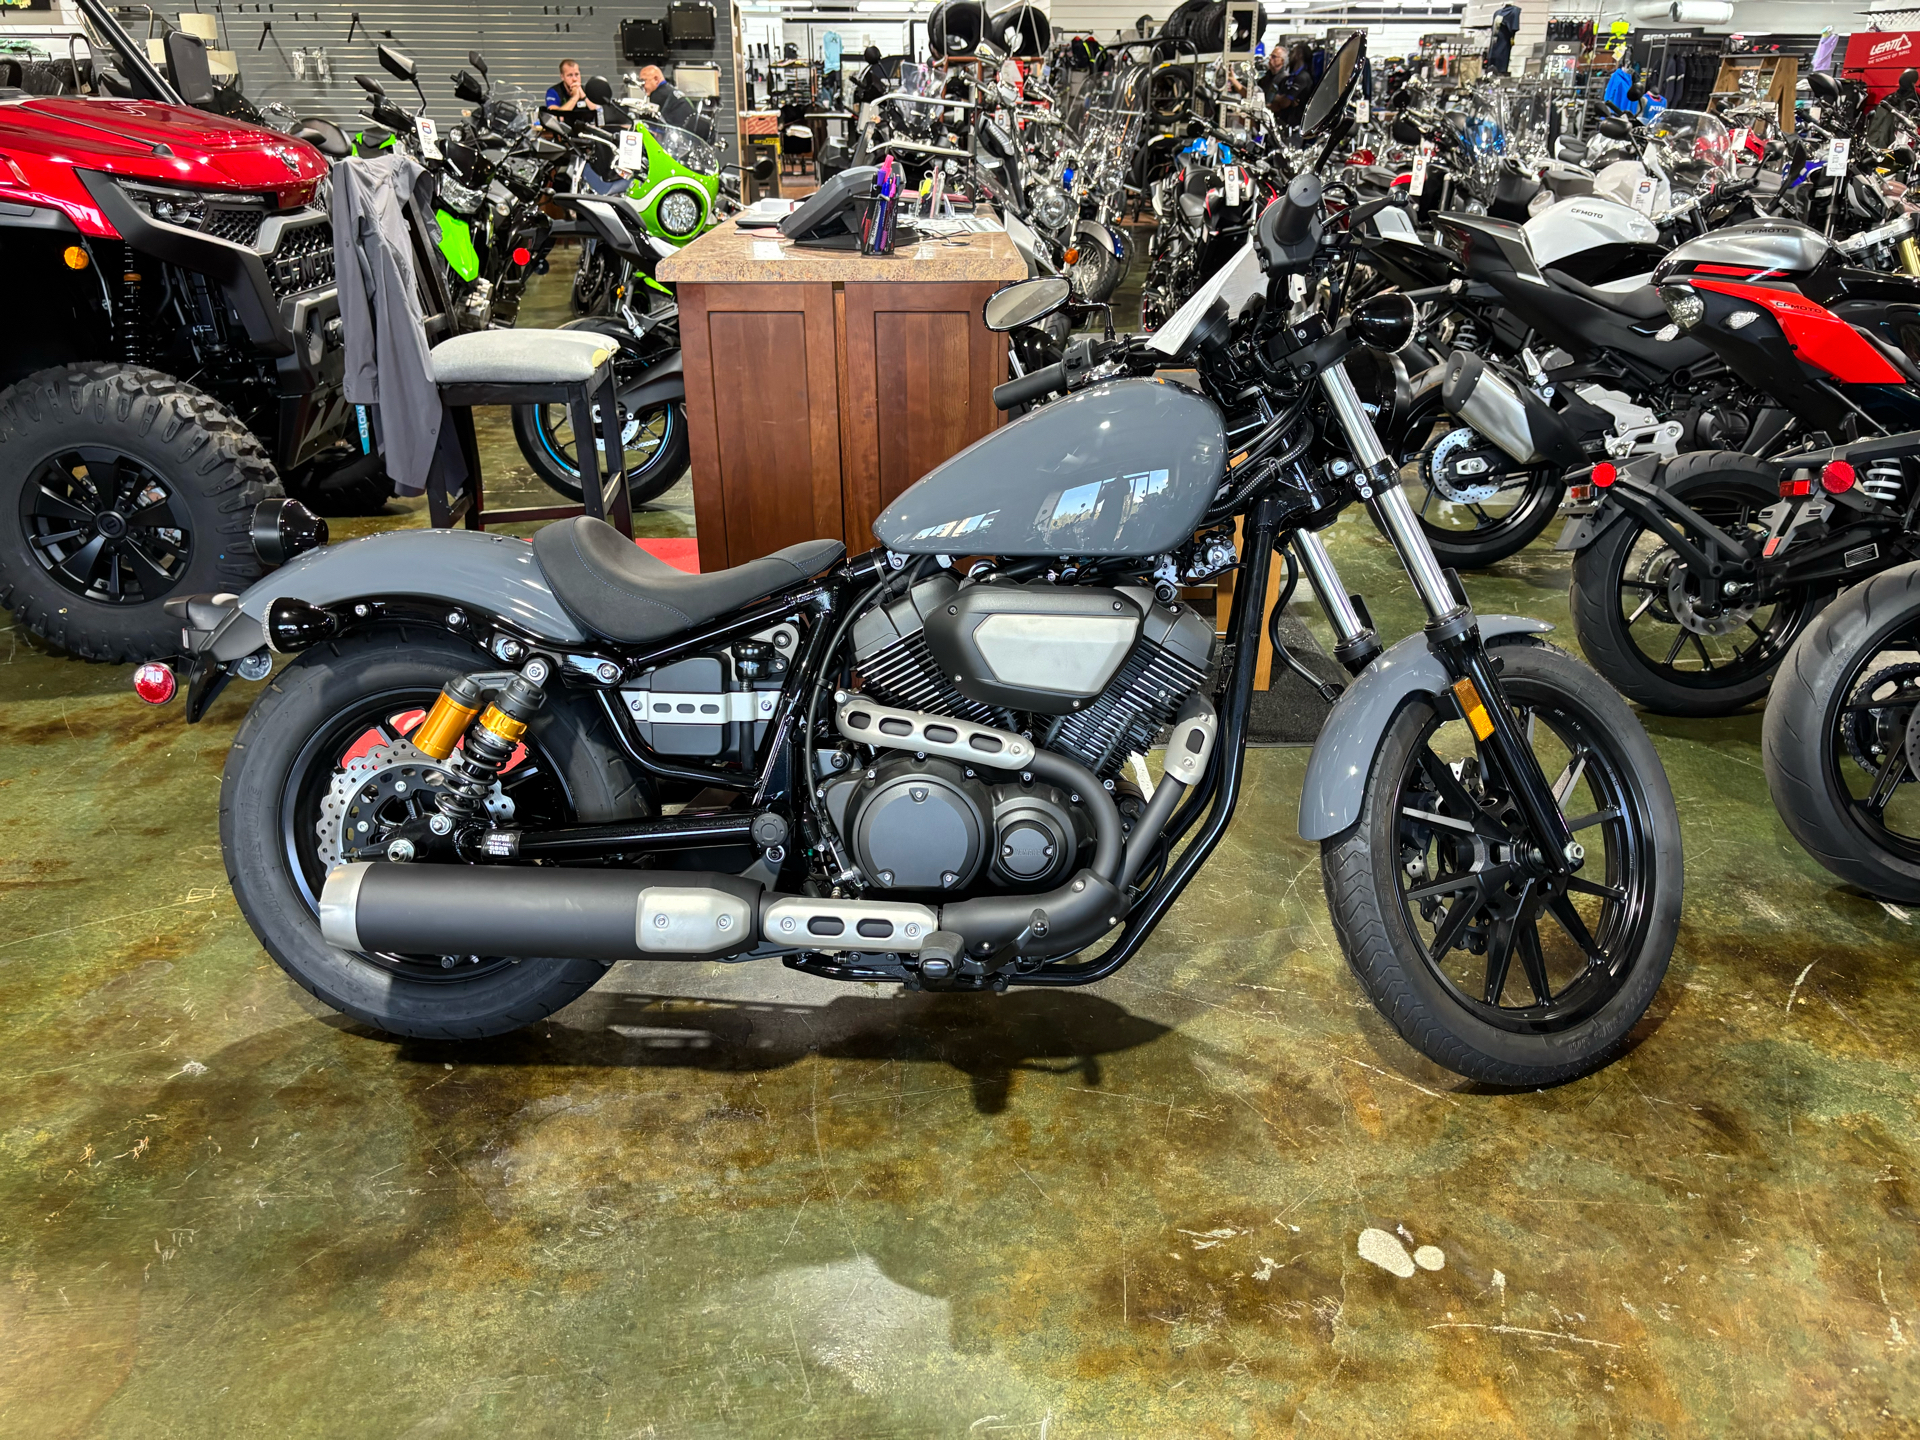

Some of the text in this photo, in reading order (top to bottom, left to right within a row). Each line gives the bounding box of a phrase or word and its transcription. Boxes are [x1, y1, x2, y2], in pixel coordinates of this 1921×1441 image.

[1571, 207, 1604, 219] CFMOTO
[1744, 227, 1790, 235] CFMOTO
[1776, 301, 1822, 314] CFMOTO
[357, 405, 368, 438] MOTO
